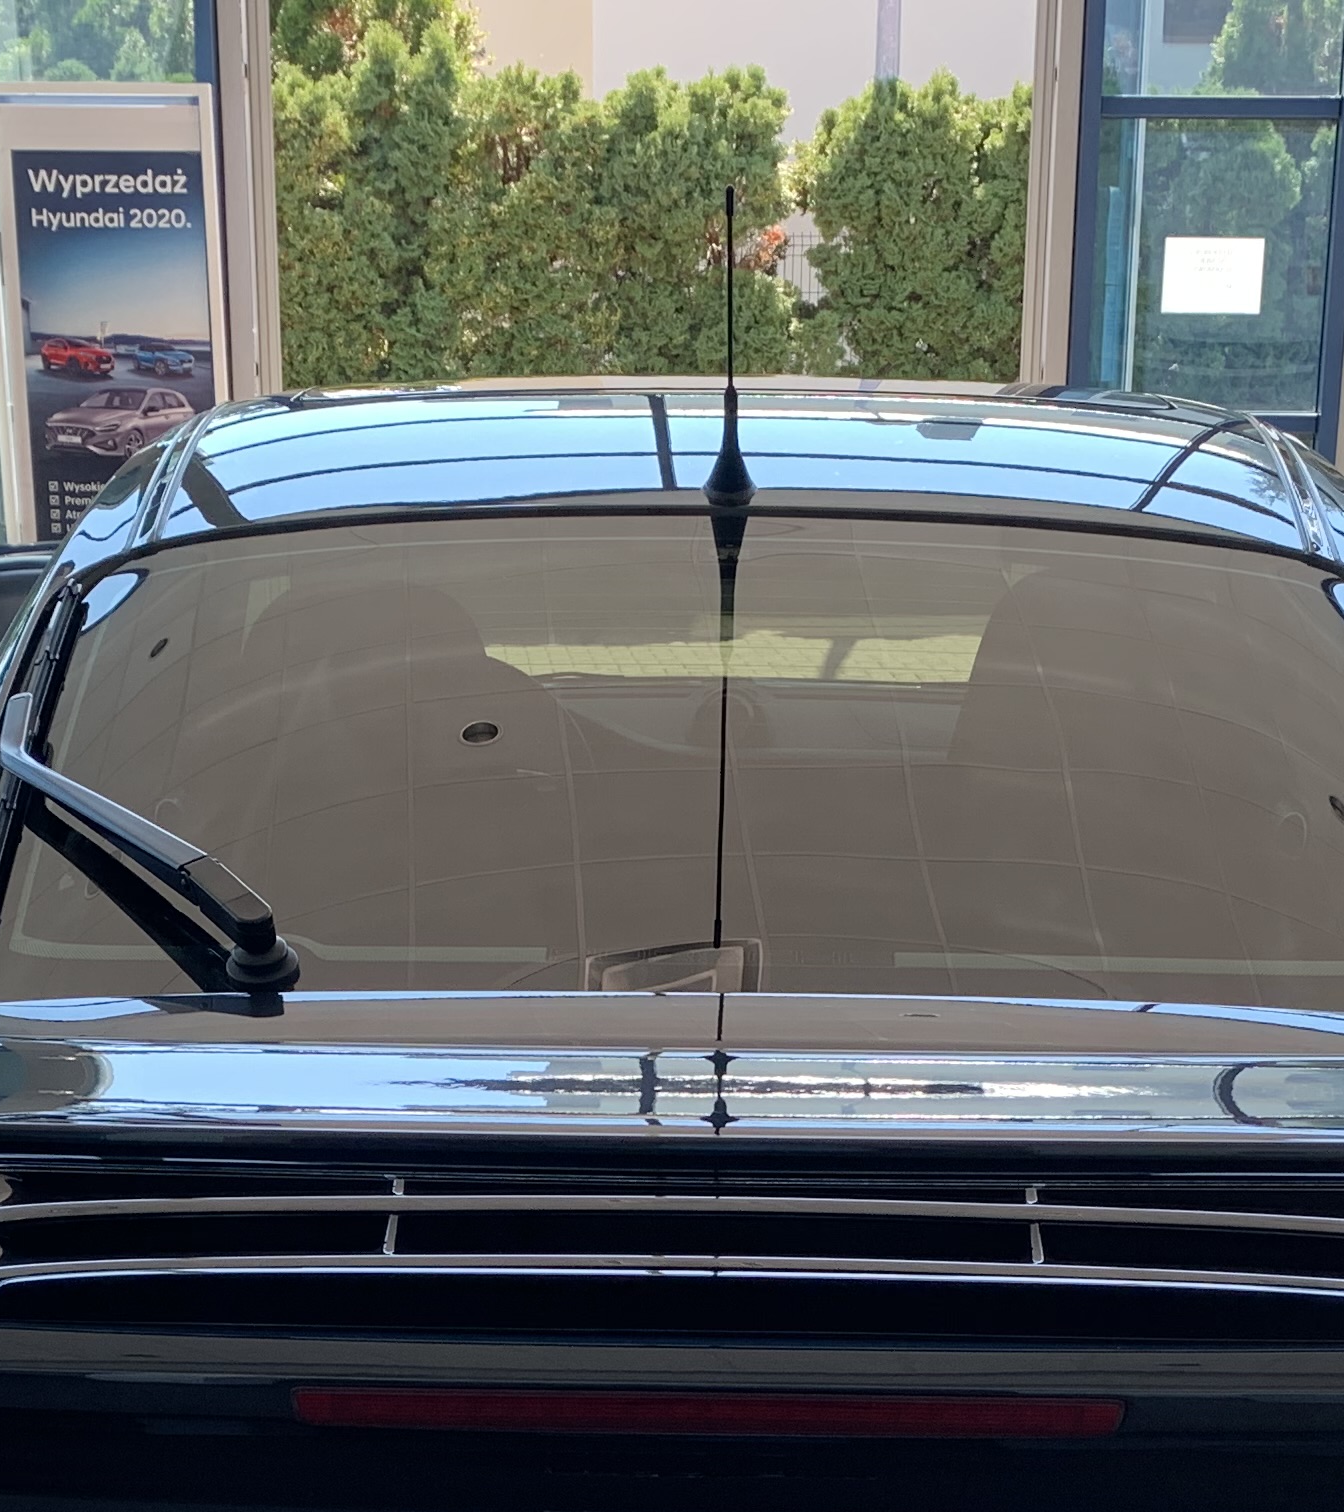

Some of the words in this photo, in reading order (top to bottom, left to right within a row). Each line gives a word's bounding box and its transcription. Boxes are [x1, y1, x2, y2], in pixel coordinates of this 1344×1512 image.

[27, 168, 188, 198] Wyprzedaż
[31, 207, 125, 232] Hyundai
[129, 208, 192, 228] 2020.
